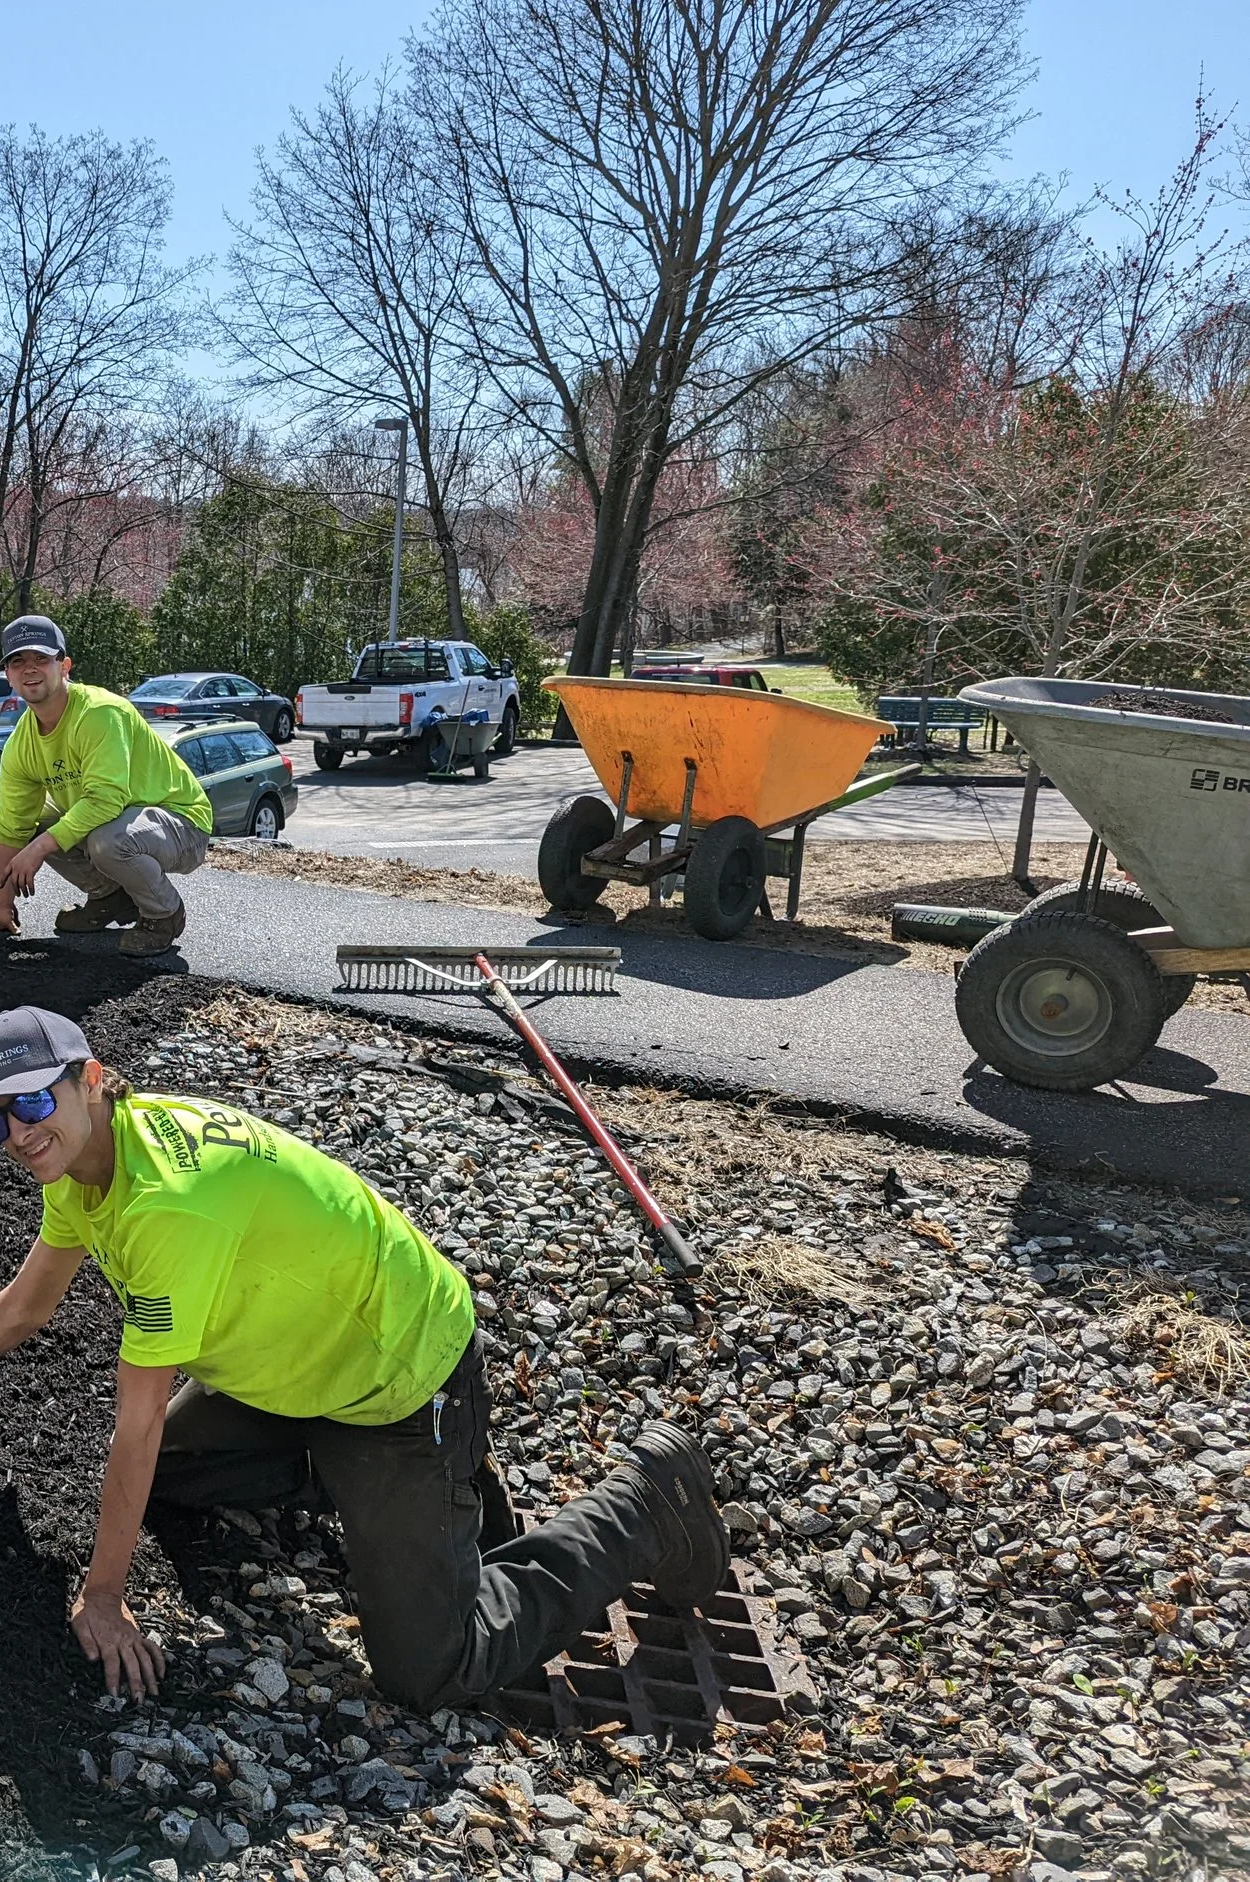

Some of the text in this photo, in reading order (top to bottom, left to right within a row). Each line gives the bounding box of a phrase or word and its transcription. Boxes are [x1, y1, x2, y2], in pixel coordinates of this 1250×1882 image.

[913, 911, 961, 926] ECHO
[159, 1119, 192, 1168] POWERED
[200, 1107, 251, 1155] Pe
